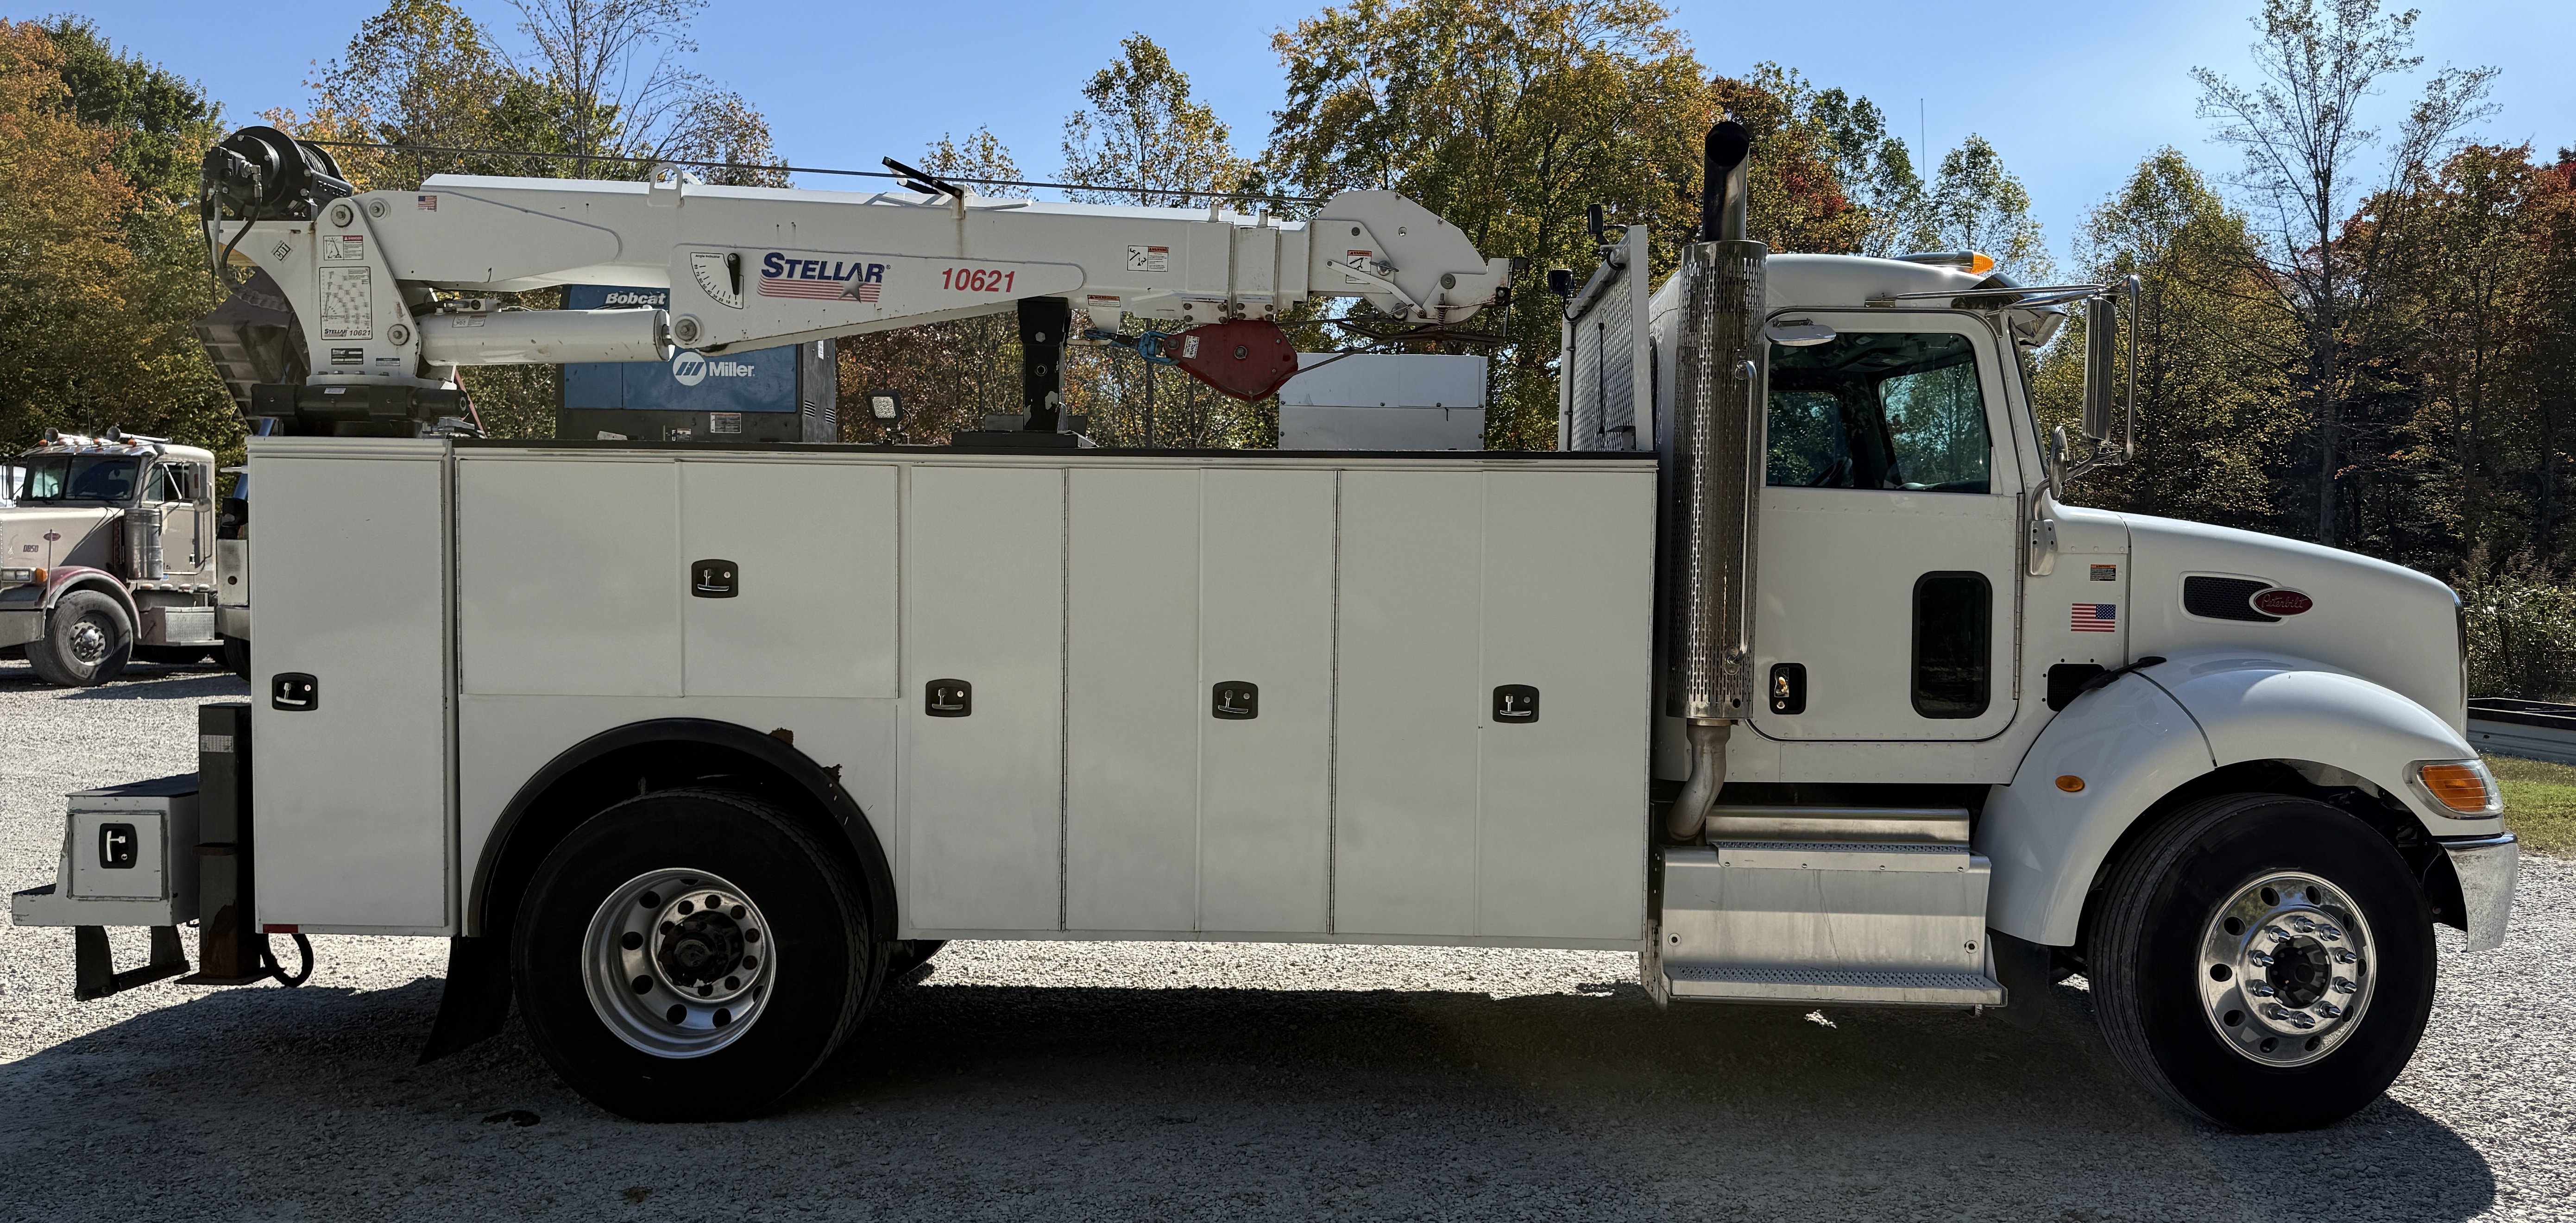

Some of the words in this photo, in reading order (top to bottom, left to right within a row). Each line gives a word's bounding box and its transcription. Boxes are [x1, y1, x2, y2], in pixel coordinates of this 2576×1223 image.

[275, 244, 290, 260] CDT
[761, 252, 885, 283] STELLAR
[942, 268, 1015, 293] 10621
[605, 292, 666, 304] Bobcat
[709, 362, 755, 377] Miller
[2261, 594, 2308, 608] Peterbilt
